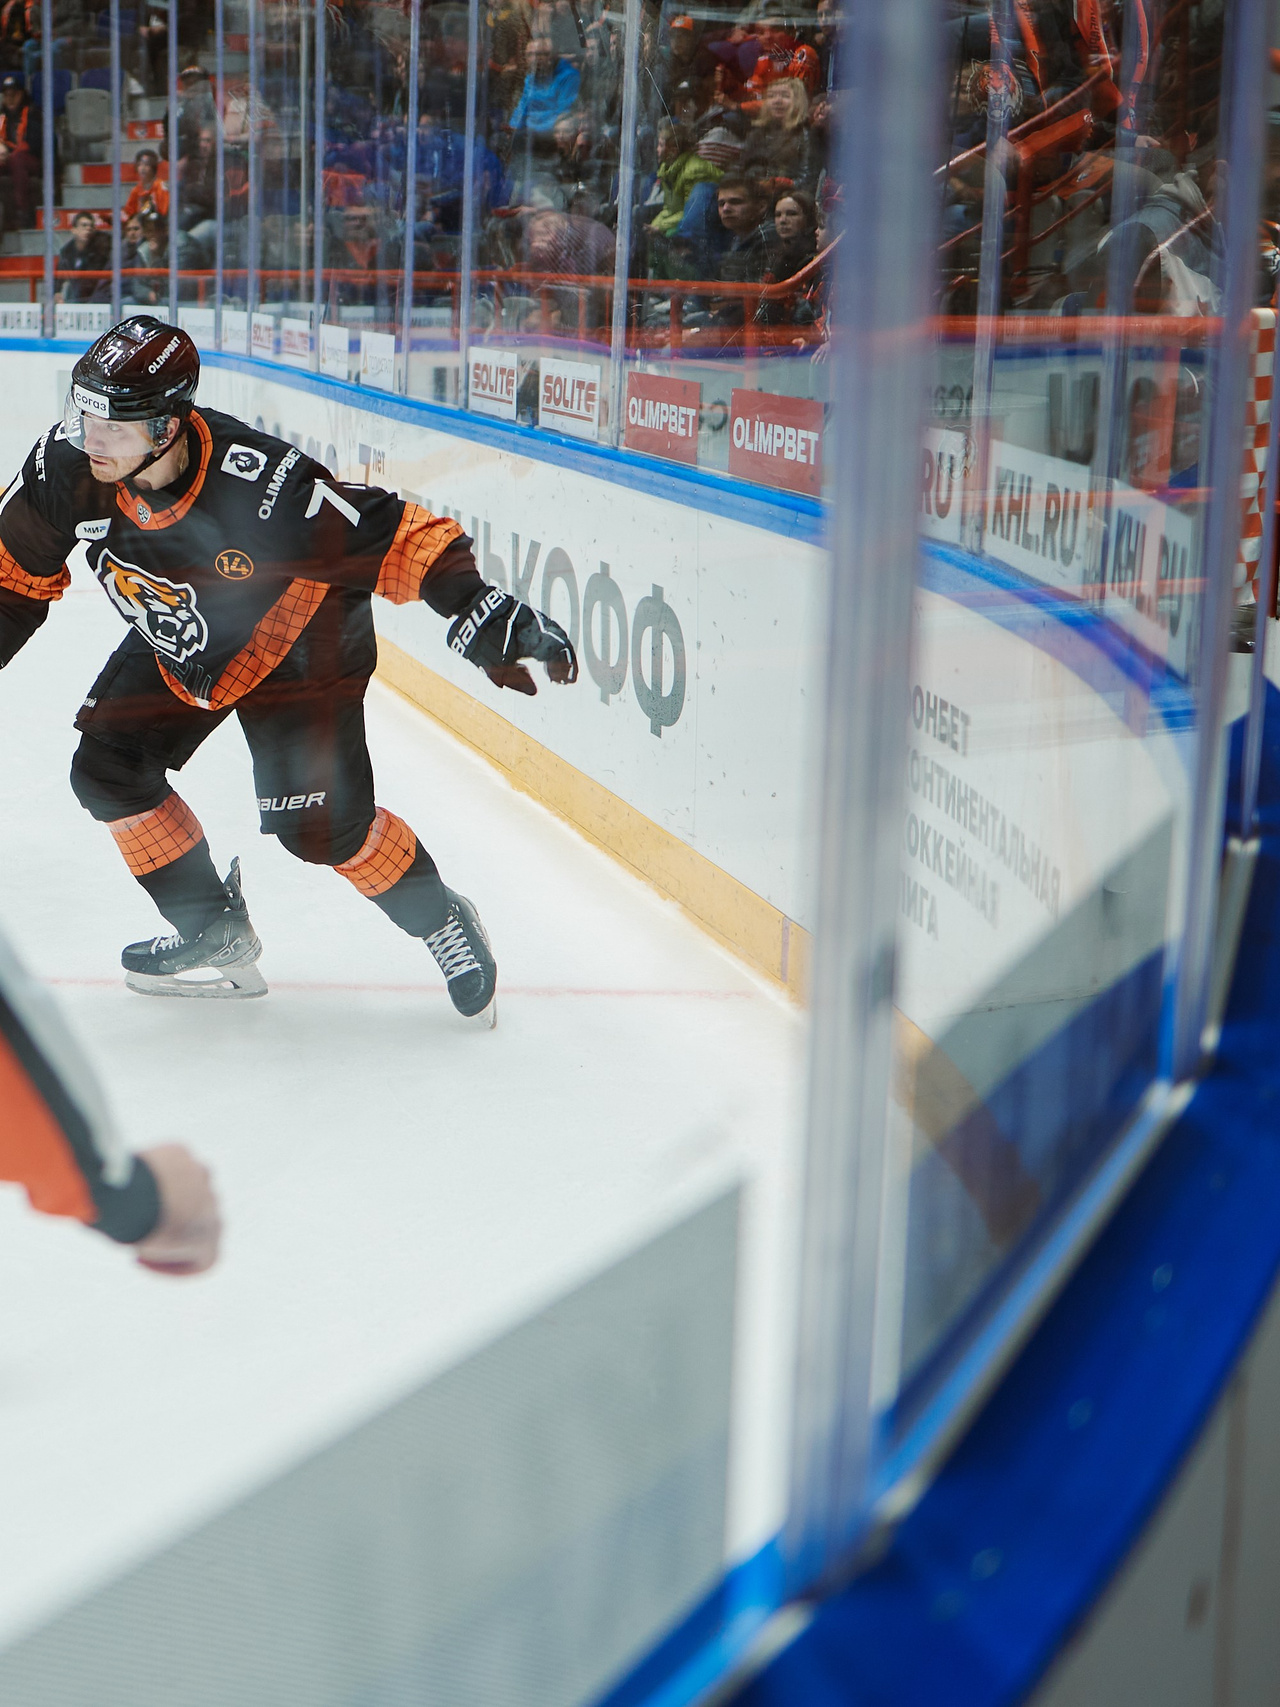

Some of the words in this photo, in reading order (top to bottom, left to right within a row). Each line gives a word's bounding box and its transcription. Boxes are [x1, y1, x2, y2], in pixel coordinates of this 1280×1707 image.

[100, 345, 124, 366] 71
[147, 335, 182, 375] OLIMPBET
[75, 391, 108, 412] согаз
[472, 362, 515, 399] SOLITE
[543, 374, 597, 414] SOLITE
[628, 396, 697, 438] OLIMPBET
[732, 416, 820, 466] OLIMPBET
[35, 430, 51, 482] PBET
[304, 478, 367, 528] 7
[991, 465, 1082, 568] KHL.RU
[401, 487, 687, 739] ЬКОФФ
[912, 684, 971, 758] ОНБЕТ
[908, 748, 1061, 921] ОНТИНЕНТАЛЬНАЯ
[906, 811, 1000, 930] ОККЕЙНАЯ
